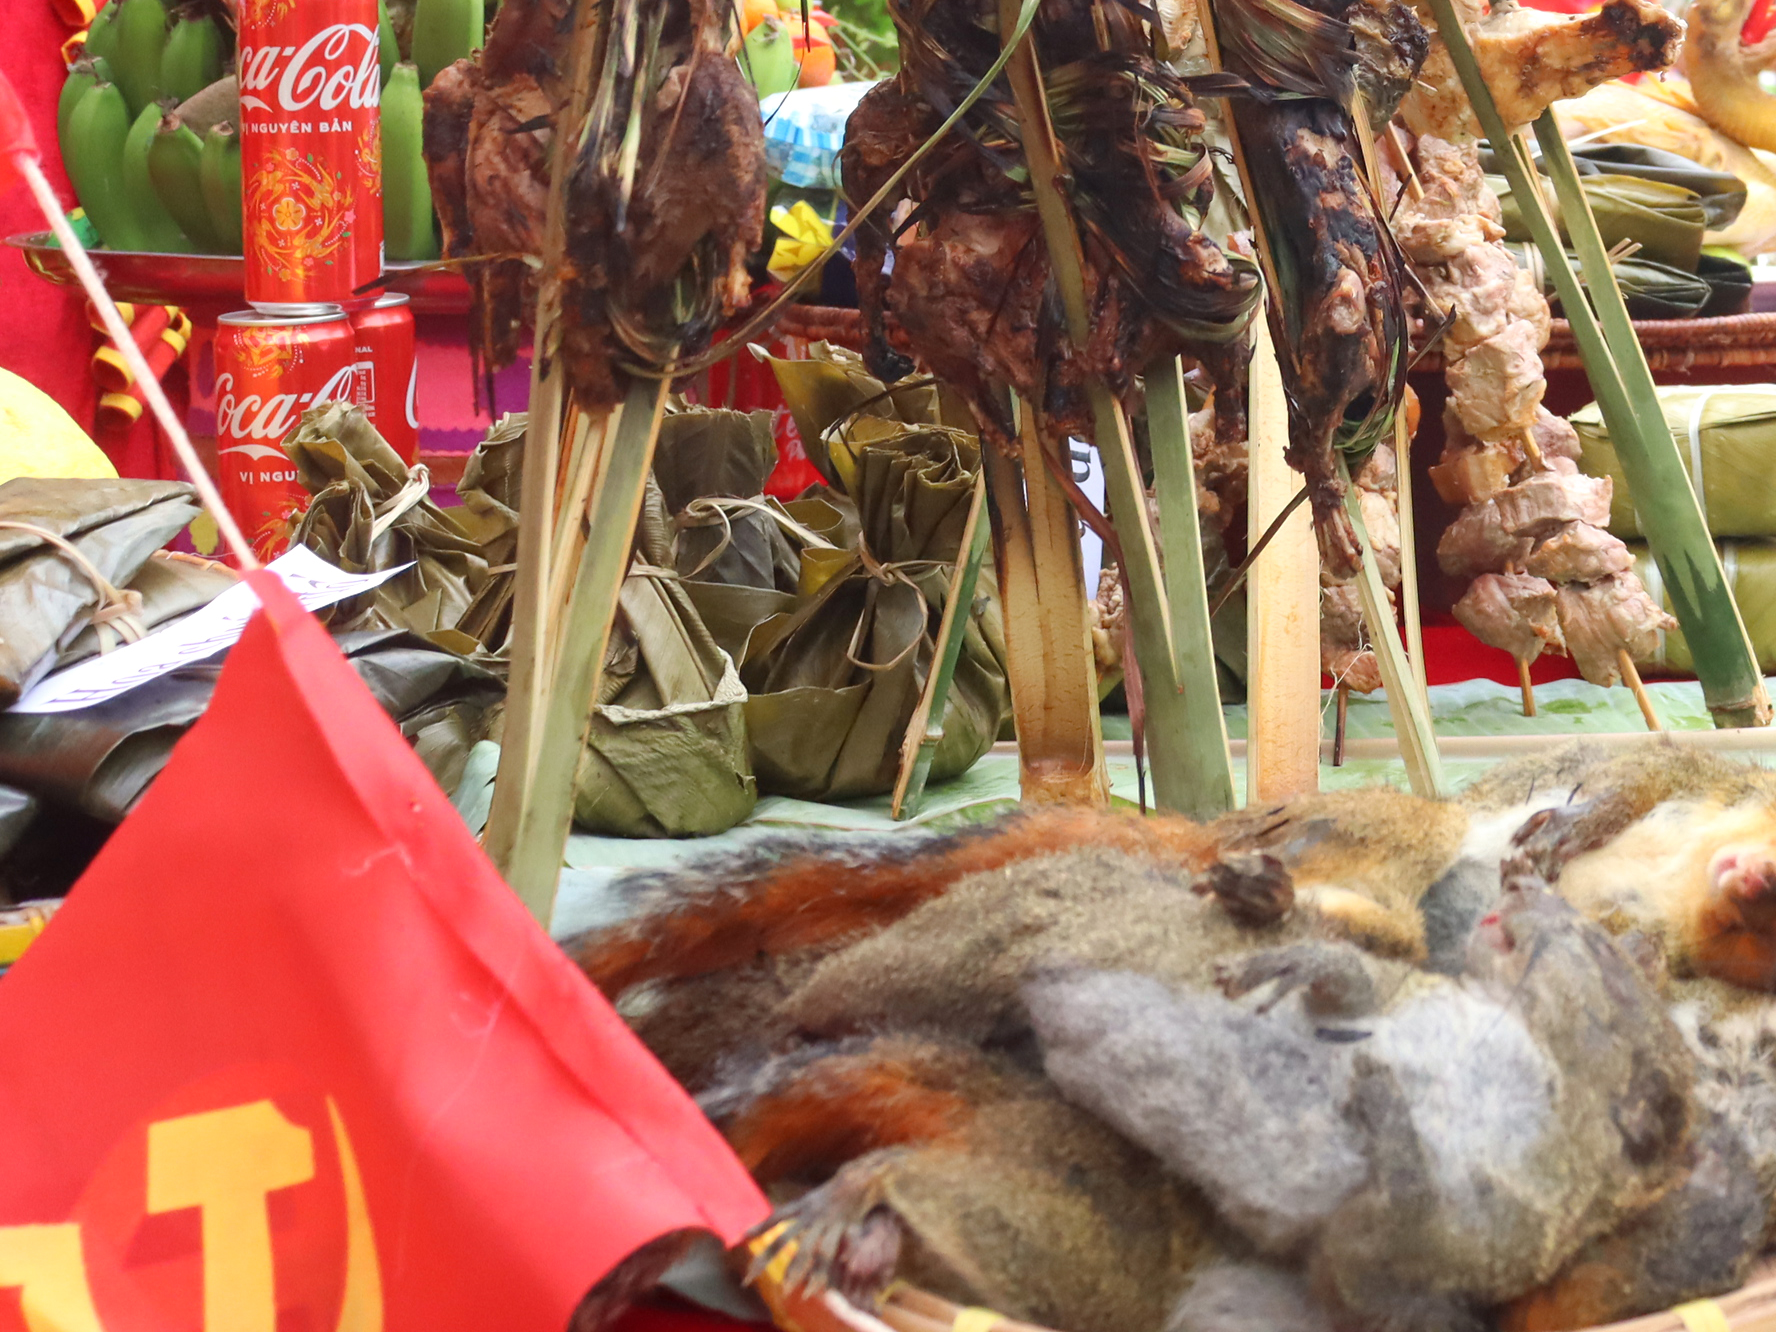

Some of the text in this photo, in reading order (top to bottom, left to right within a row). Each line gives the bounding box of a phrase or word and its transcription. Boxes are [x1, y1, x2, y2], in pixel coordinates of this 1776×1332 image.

[251, 120, 312, 134] NGUYÊN
[319, 117, 353, 133] BẢN
[260, 470, 300, 483] NGU
